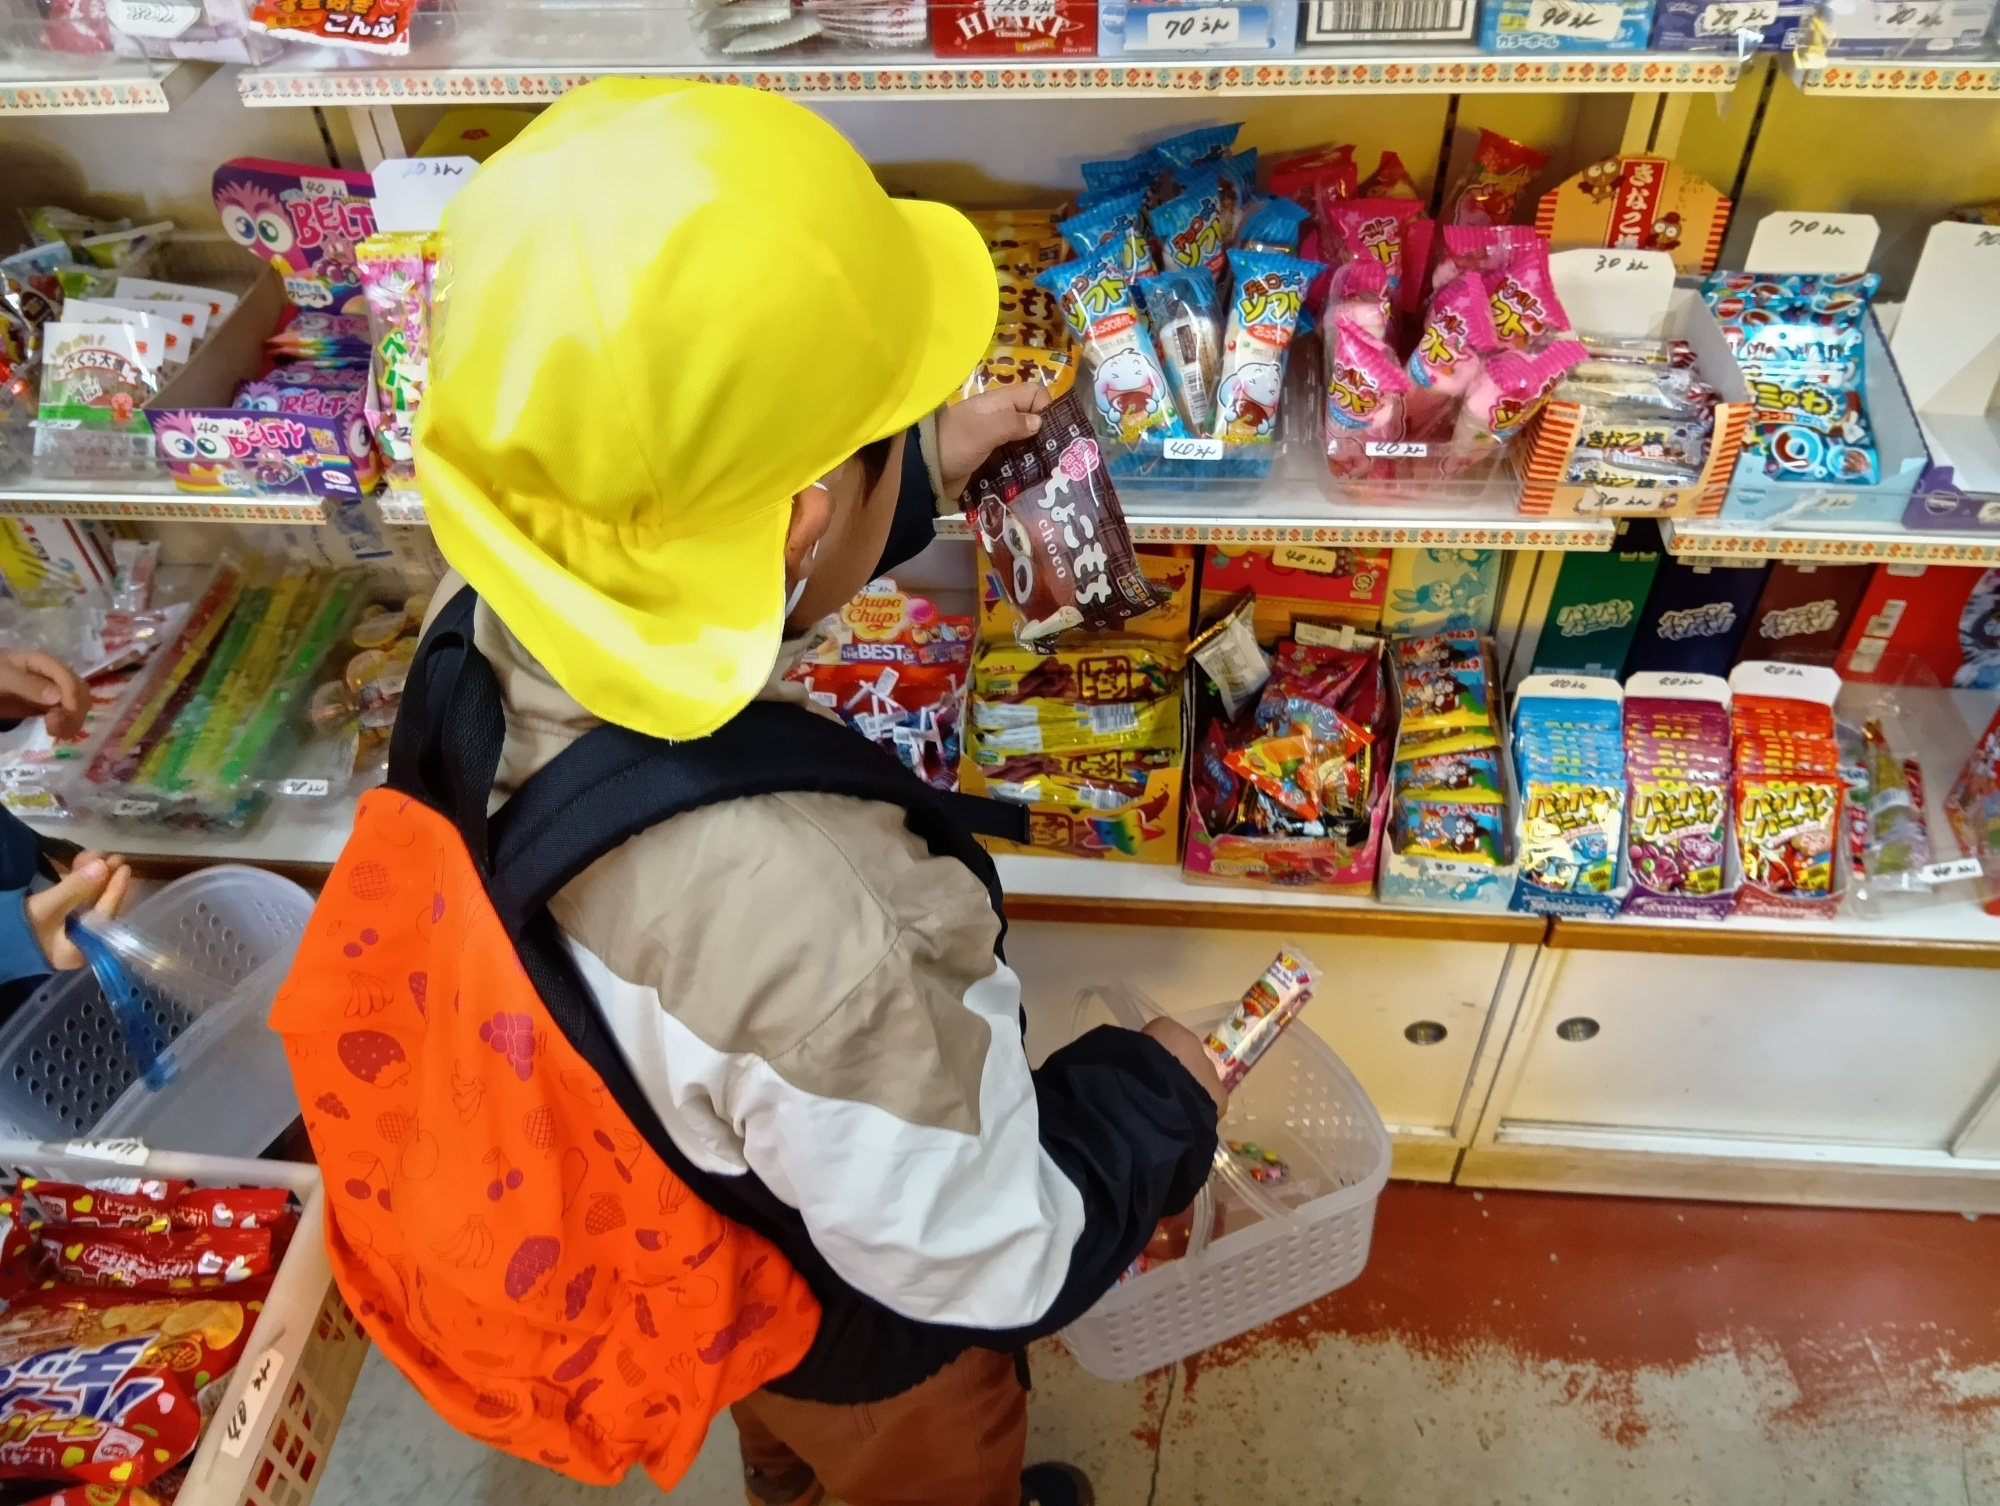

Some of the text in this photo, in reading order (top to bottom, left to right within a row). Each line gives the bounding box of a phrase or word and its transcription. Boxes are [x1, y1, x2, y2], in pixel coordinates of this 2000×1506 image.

[324, 13, 397, 38] こんぶ
[955, 10, 1071, 40] HEART
[1540, 8, 1569, 28] 90
[1165, 17, 1195, 39] 70
[288, 196, 373, 247] BELT
[1789, 220, 1820, 236] 70
[1594, 255, 1621, 272] 30
[197, 422, 219, 434] 40
[1169, 441, 1194, 455] 40
[1374, 443, 1400, 455] 40
[1038, 519, 1067, 579] choco
[850, 593, 902, 608] Chupa
[849, 607, 901, 624] Chups
[857, 643, 906, 662] BEST
[228, 1401, 248, 1441] 40
